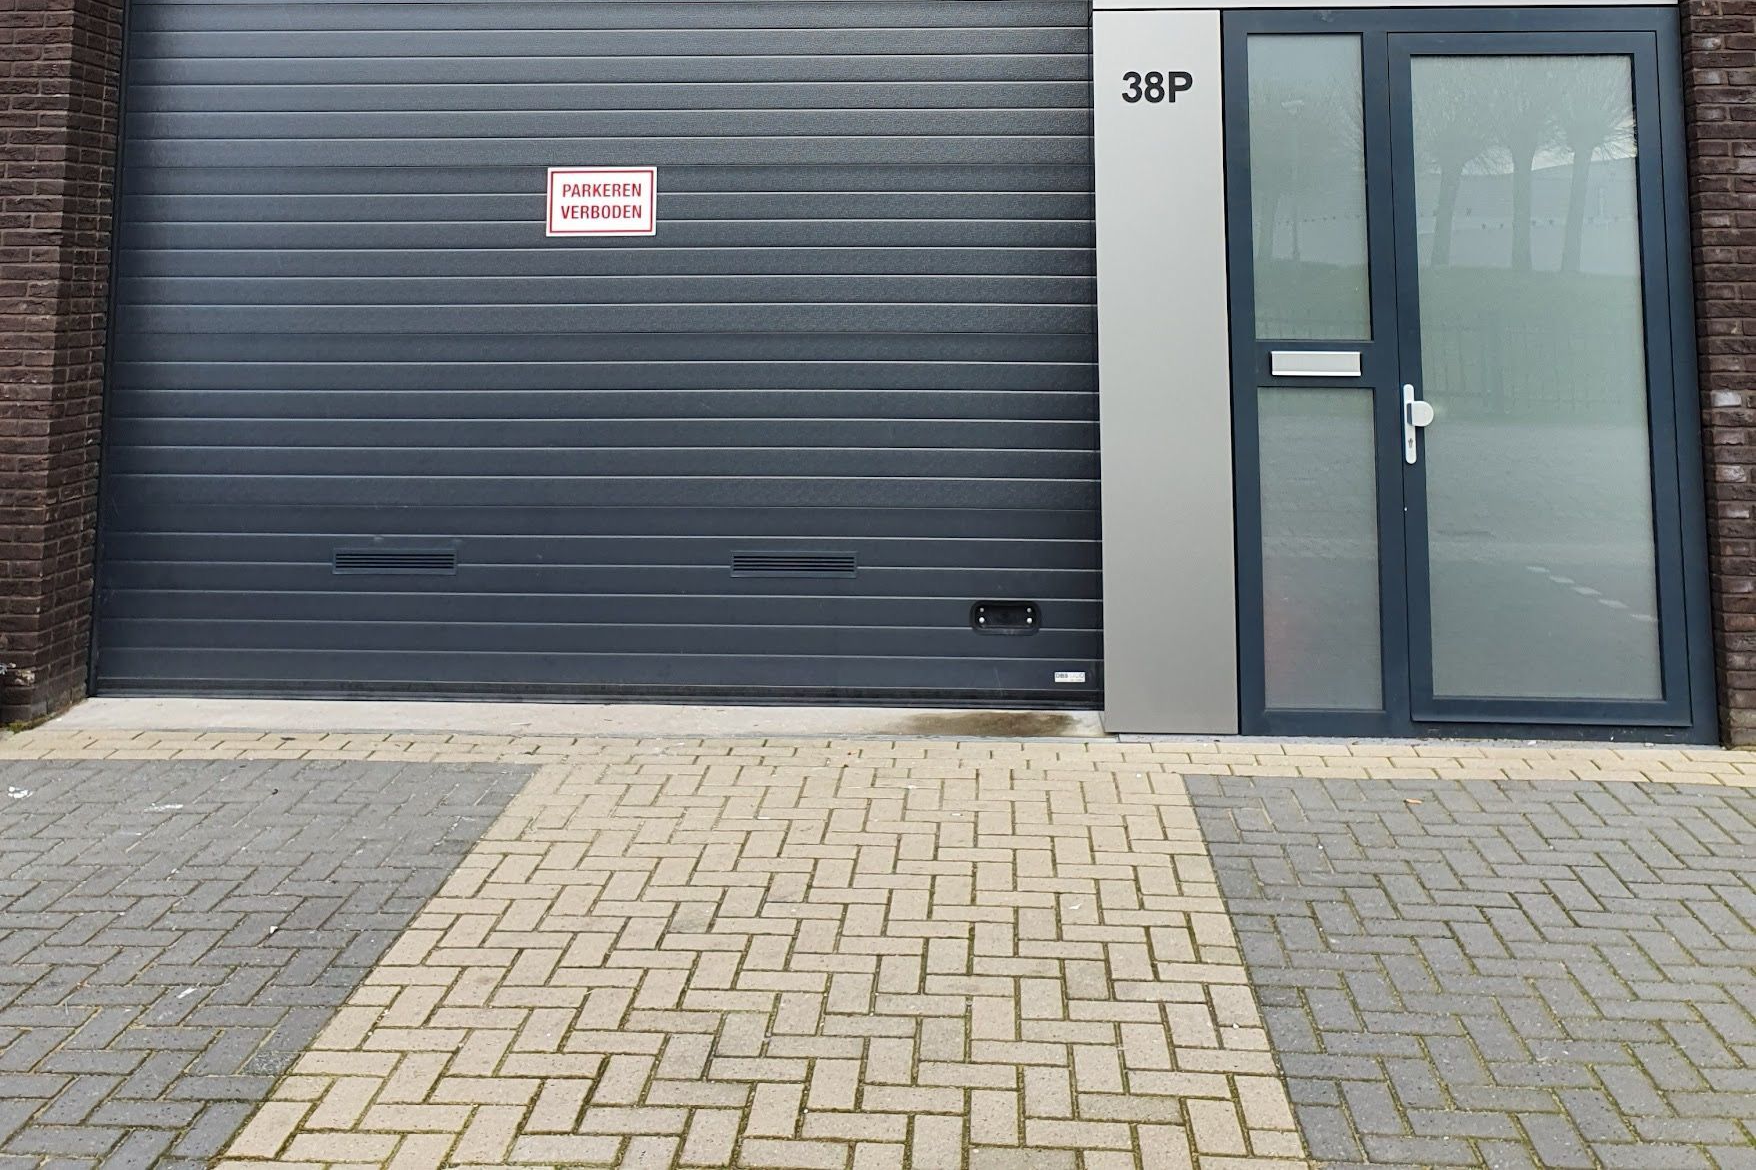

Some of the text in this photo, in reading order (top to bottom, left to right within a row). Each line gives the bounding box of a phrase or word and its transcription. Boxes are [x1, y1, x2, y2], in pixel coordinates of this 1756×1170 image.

[1121, 71, 1193, 103] 38P
[562, 183, 642, 198] PARKEREN
[561, 205, 642, 219] VERBODEN
